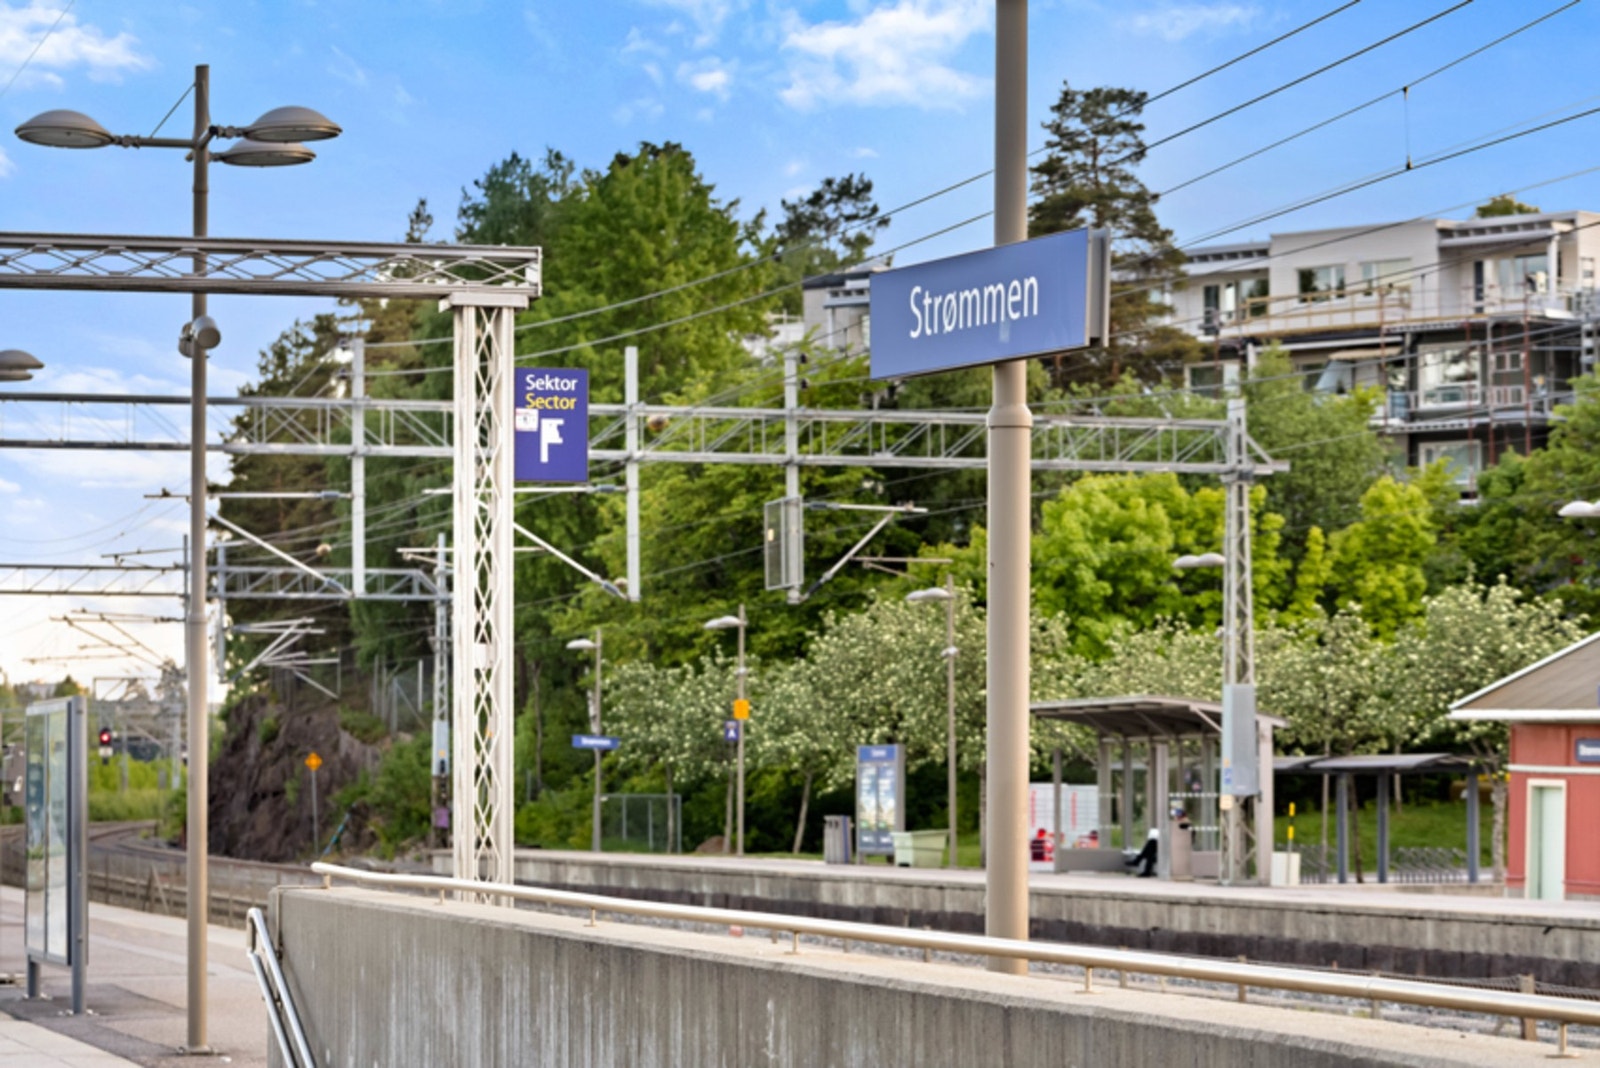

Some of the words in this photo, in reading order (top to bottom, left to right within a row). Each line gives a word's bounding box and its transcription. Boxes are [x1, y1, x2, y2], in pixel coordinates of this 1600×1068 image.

[910, 276, 1039, 339] Strømmen
[525, 374, 578, 391] Sektor
[525, 393, 577, 410] Sector
[540, 418, 565, 463] F
